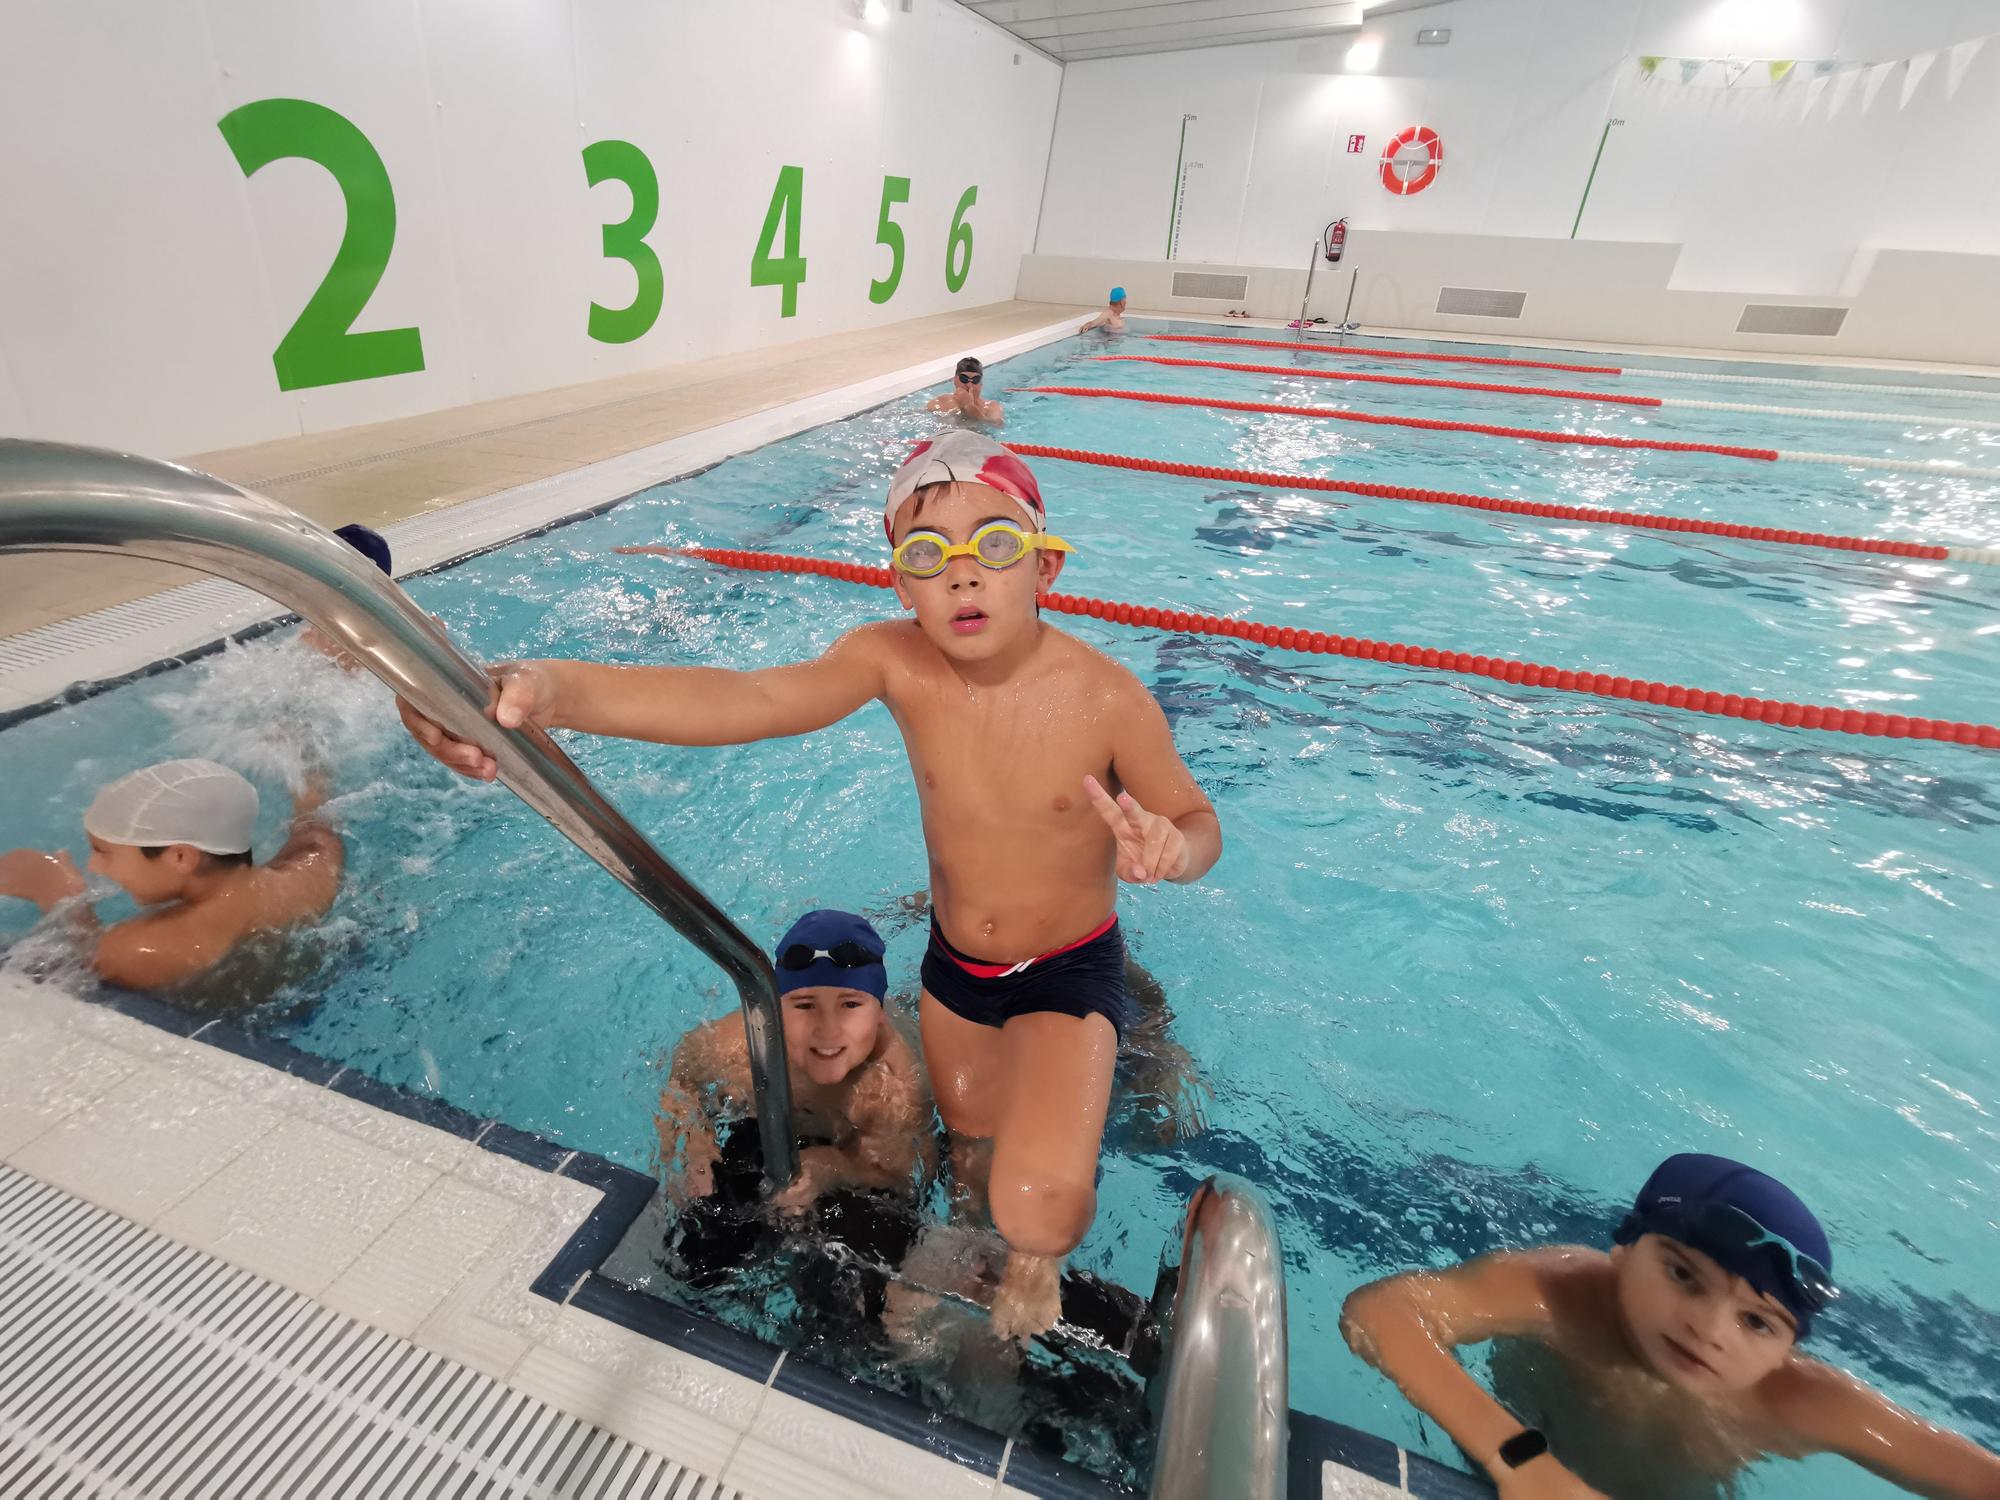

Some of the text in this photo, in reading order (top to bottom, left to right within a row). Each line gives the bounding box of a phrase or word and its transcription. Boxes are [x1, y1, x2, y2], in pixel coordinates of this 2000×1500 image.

[1608, 117, 1625, 126] 20m
[219, 99, 424, 390] 2
[582, 140, 664, 344] 3
[750, 166, 807, 317] 4
[869, 176, 910, 304] 5
[945, 186, 978, 293] 6
